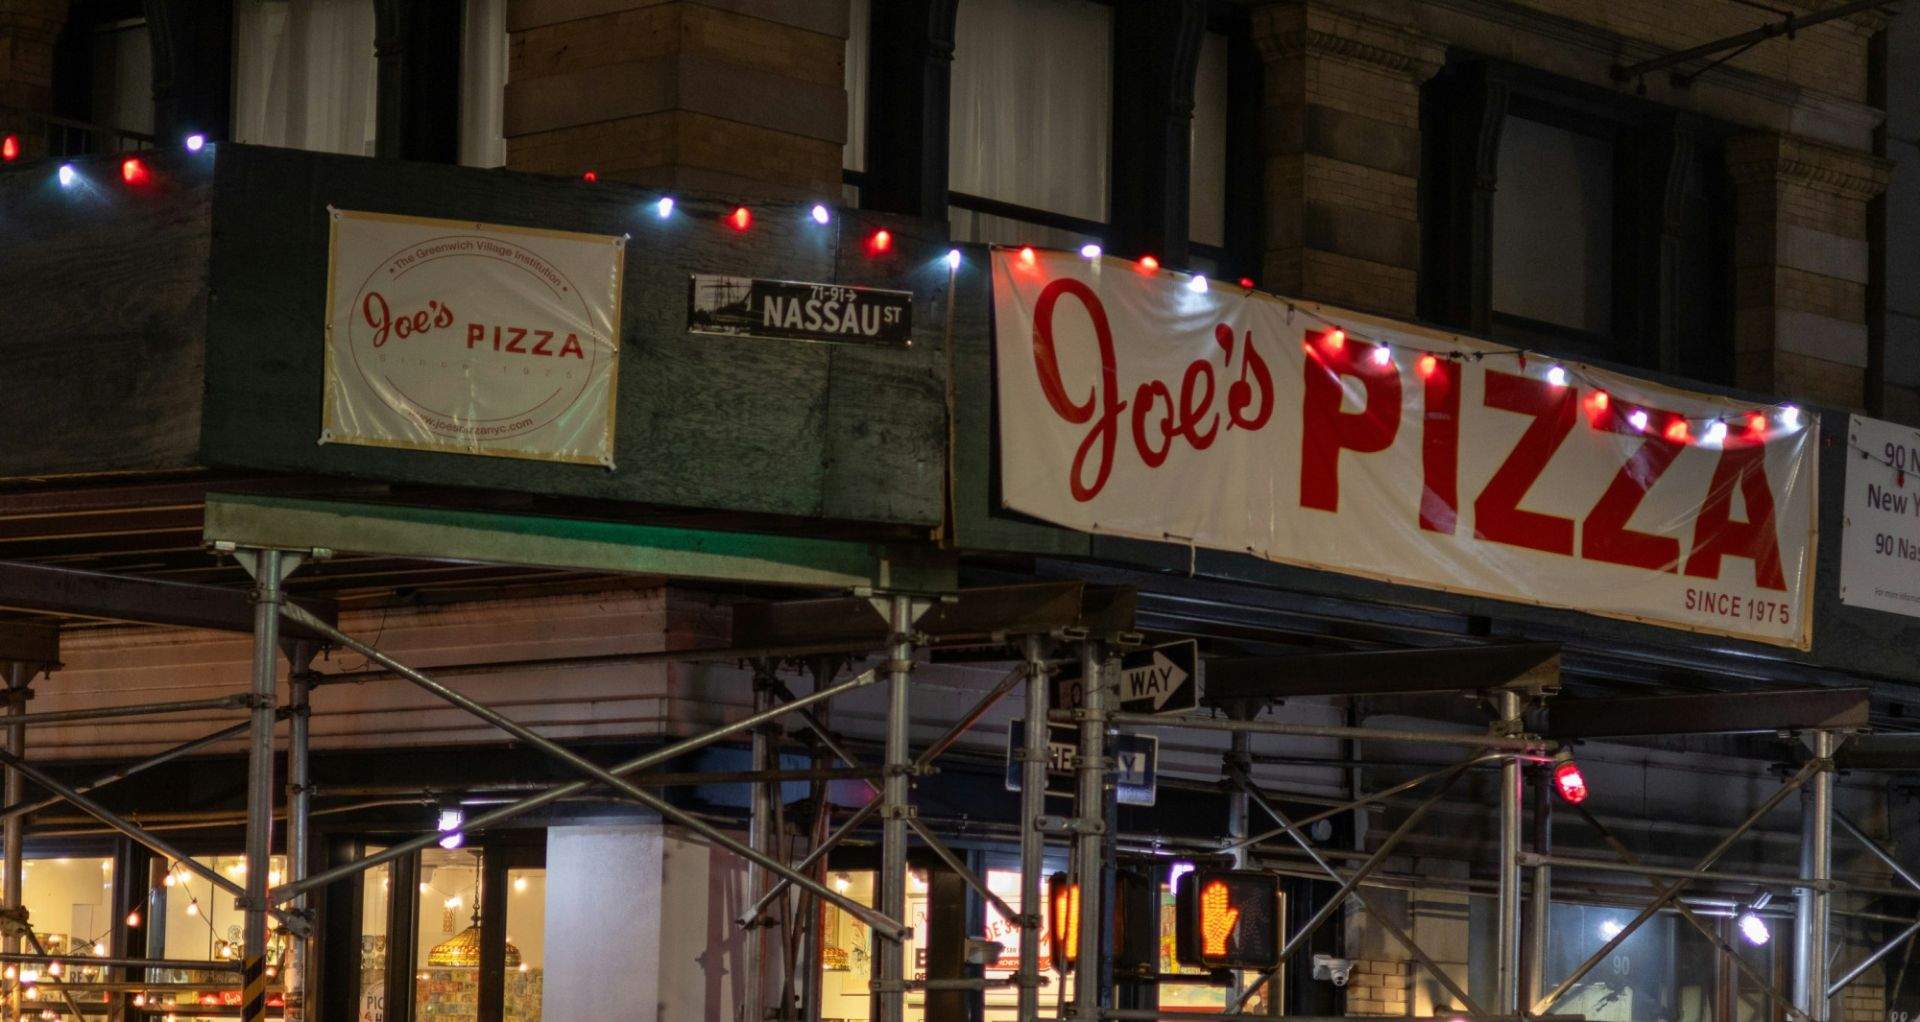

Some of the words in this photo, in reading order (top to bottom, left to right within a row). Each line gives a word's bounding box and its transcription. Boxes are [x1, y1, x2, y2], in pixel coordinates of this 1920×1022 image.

[393, 254, 415, 270] The
[416, 240, 474, 260] Greenwich
[476, 241, 513, 260] Village
[514, 249, 563, 287] Institution
[810, 285, 845, 303] 71-91
[363, 291, 455, 348] Joe's
[466, 323, 585, 360] PIZZA
[763, 295, 881, 337] NASSAU
[883, 306, 903, 323] ST
[1032, 276, 1275, 502] Joe's
[1299, 329, 1787, 592] PIZZA
[1884, 442, 1905, 469] 90
[1867, 483, 1907, 515] New
[1875, 533, 1893, 556] 90
[1685, 588, 1742, 618] SINCE
[1747, 598, 1791, 626] 1975
[1129, 666, 1173, 697] WAY
[1612, 955, 1631, 976] 90
